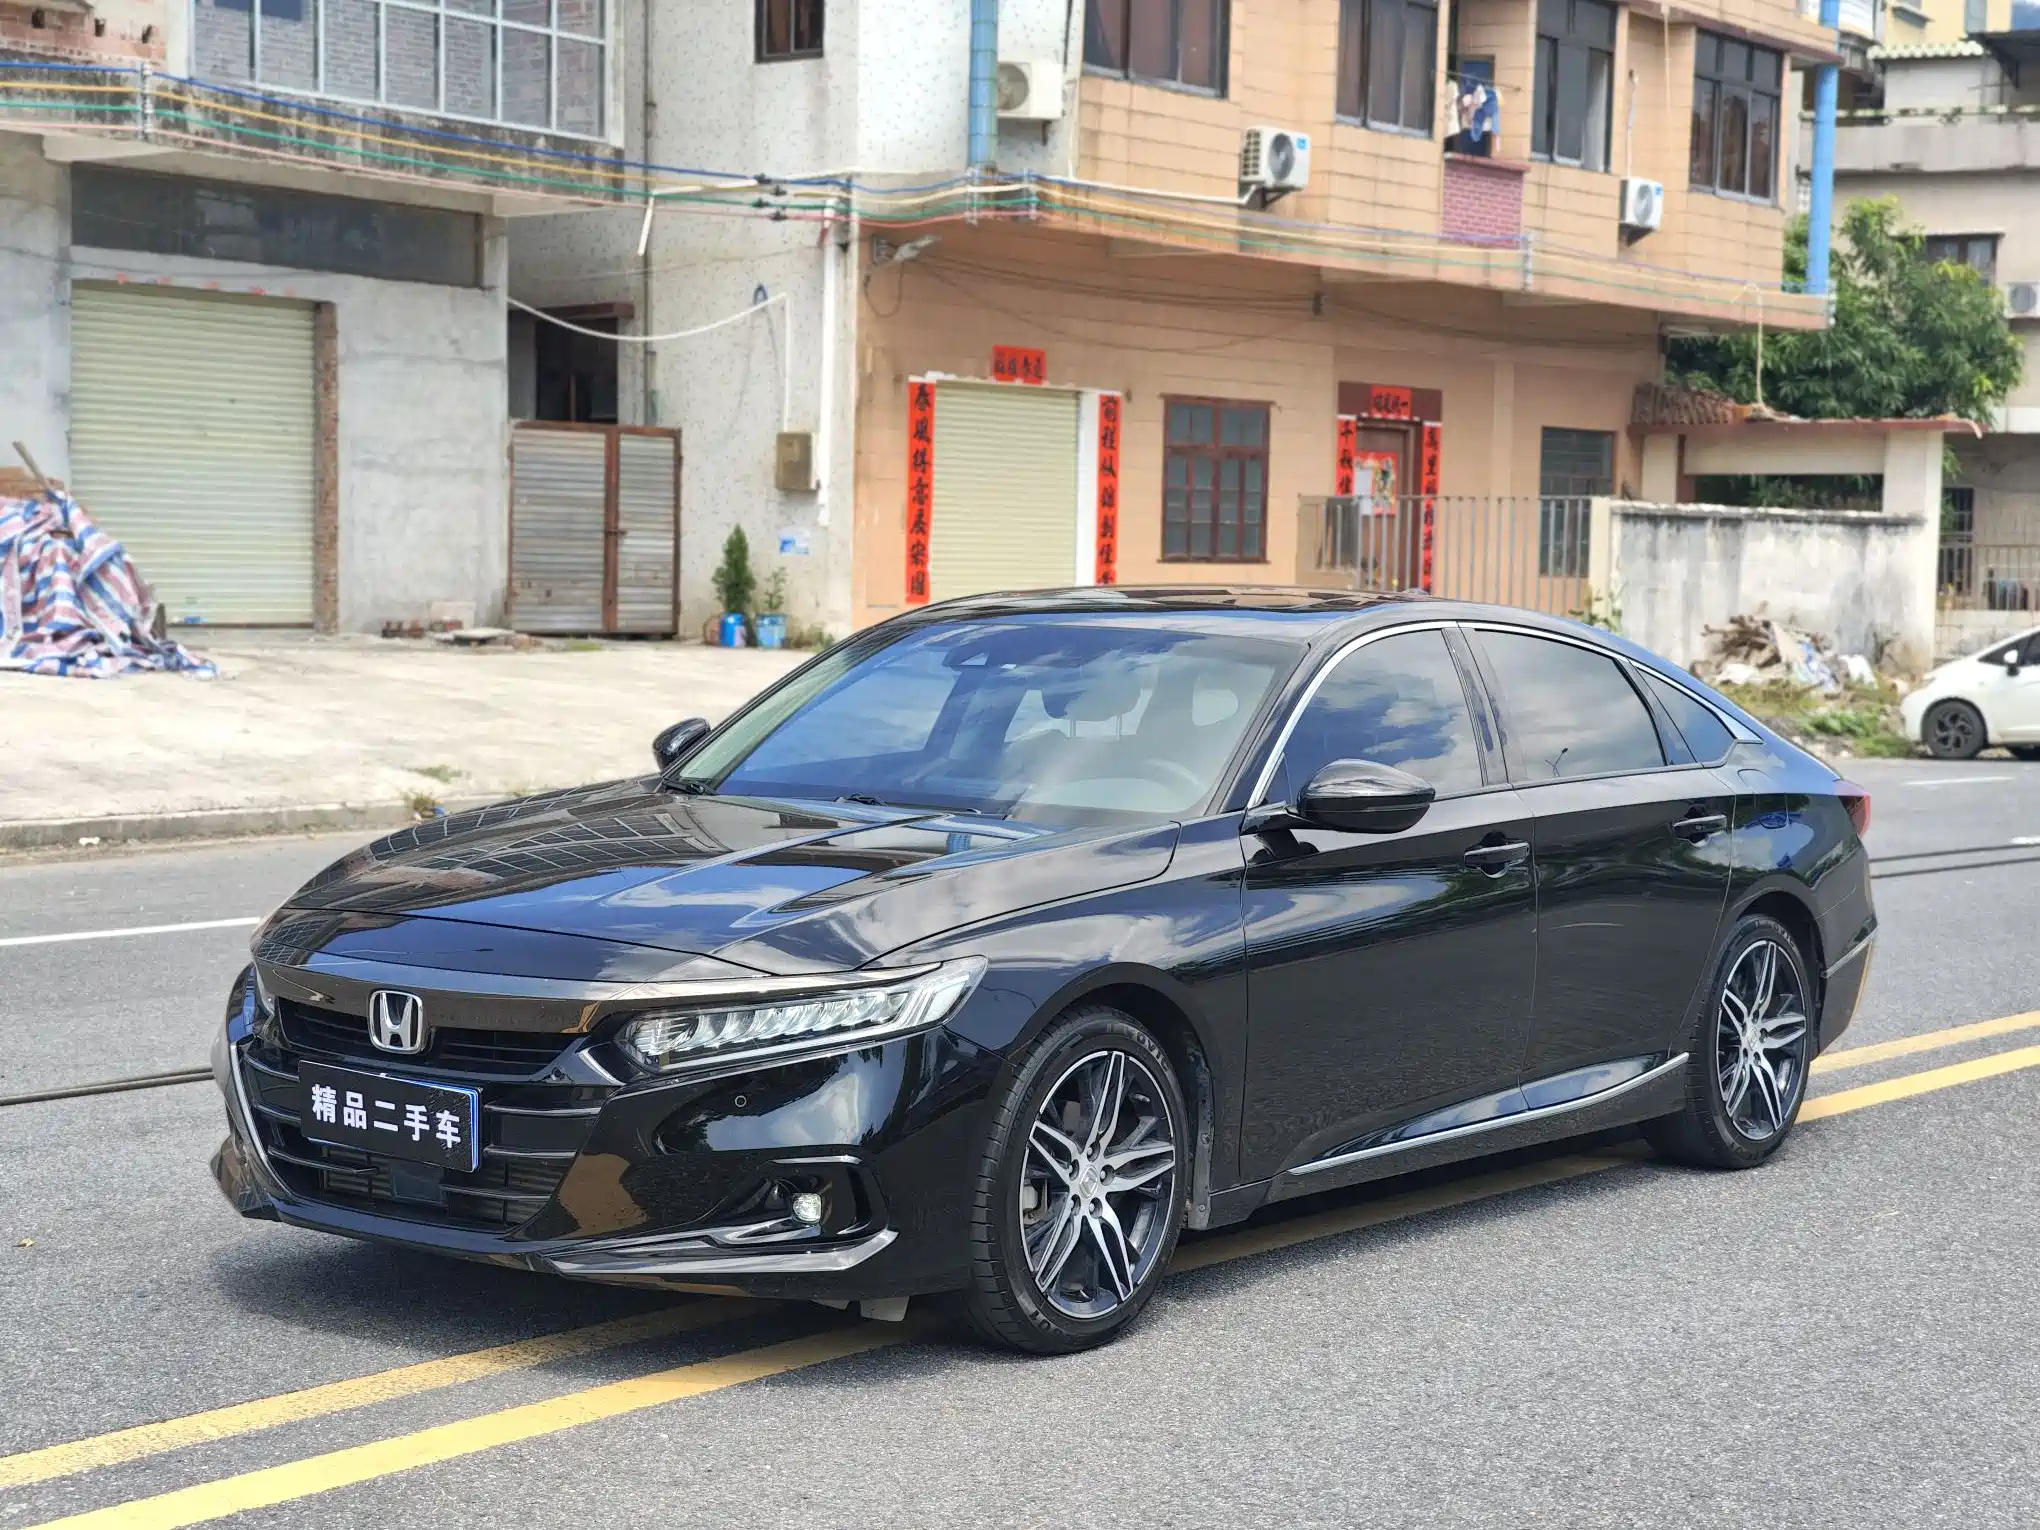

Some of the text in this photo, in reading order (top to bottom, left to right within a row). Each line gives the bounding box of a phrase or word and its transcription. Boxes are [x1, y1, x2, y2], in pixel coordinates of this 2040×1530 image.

[311, 1083, 462, 1149] 精品二手车
